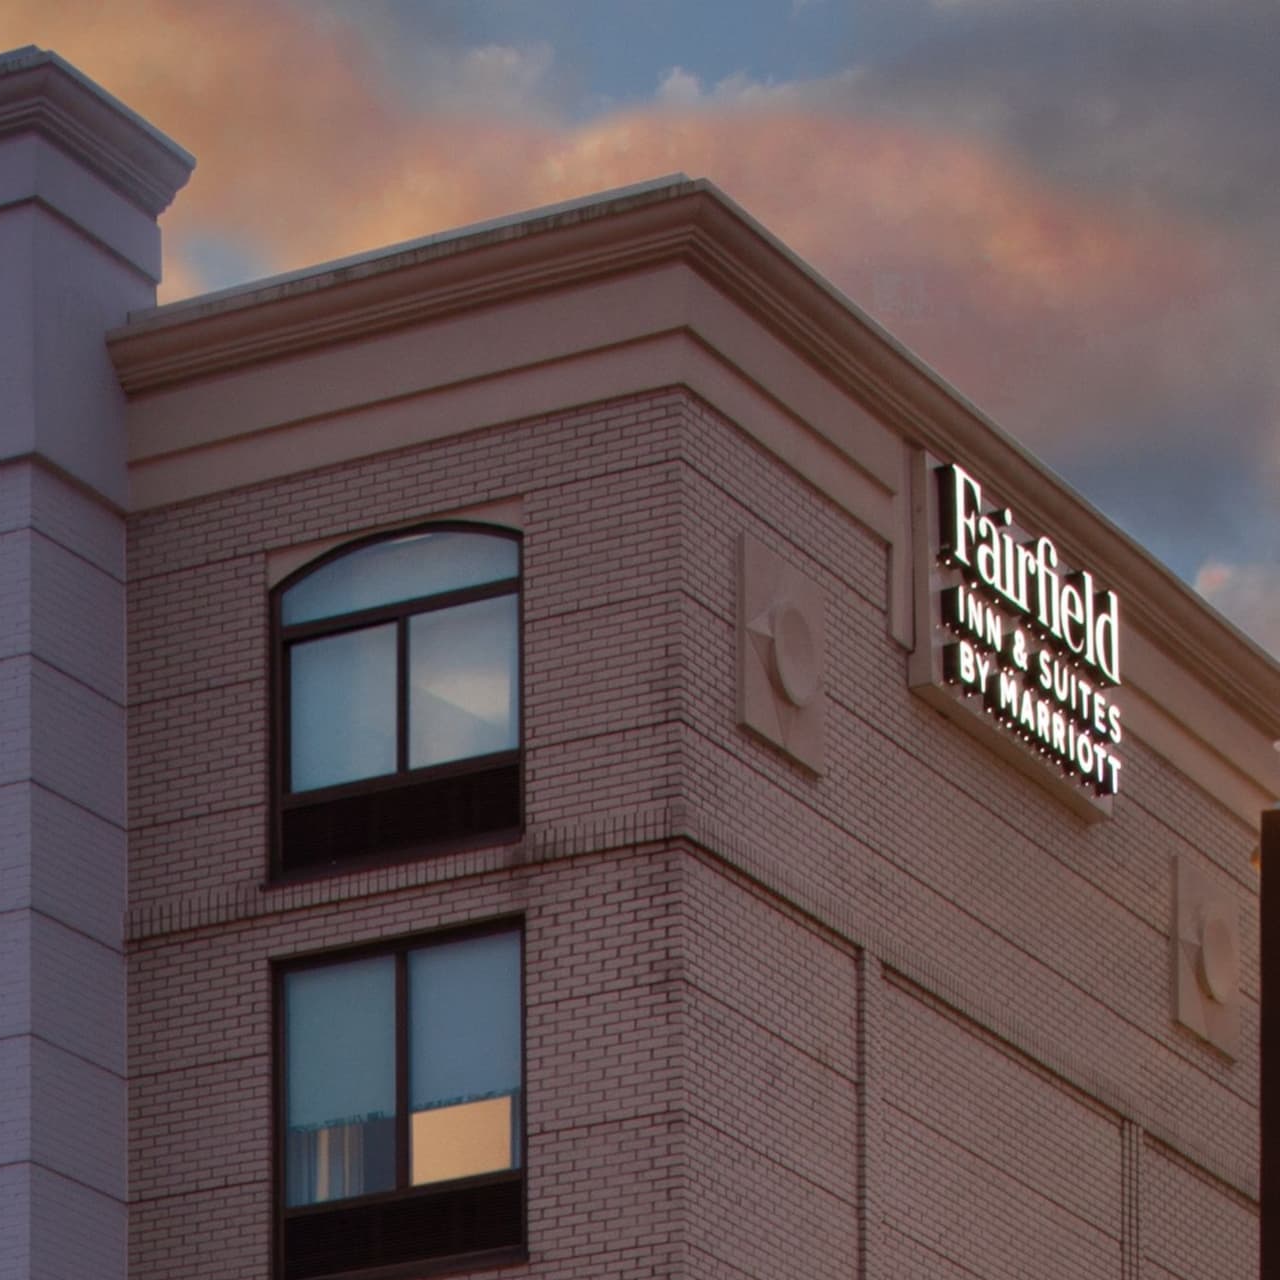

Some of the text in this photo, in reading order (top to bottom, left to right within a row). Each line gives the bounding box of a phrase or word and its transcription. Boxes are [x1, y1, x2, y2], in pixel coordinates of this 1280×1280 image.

[952, 463, 1122, 685] Fairfield
[958, 585, 1122, 745] INN & SUITES
[959, 640, 1122, 794] BY MARRIOTT
